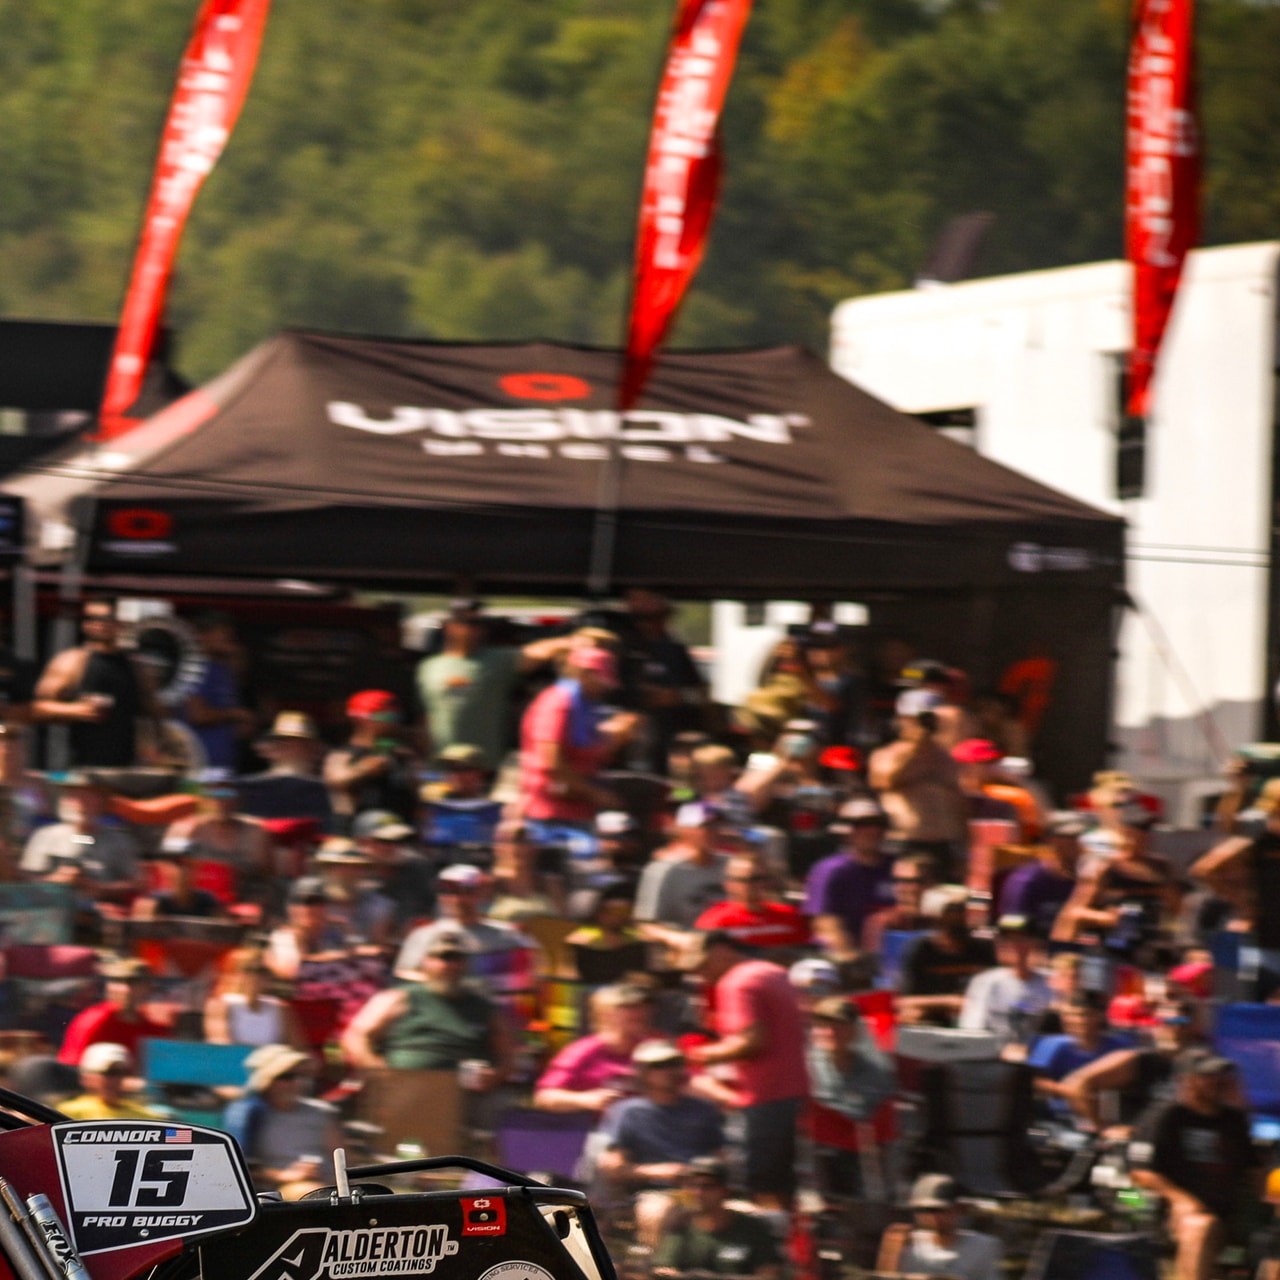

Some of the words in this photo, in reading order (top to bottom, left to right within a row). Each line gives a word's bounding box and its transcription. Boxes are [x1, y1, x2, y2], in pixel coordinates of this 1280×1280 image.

[327, 401, 791, 443] VISION
[64, 1130, 161, 1143] CONNOR
[108, 1150, 194, 1207] 15
[82, 1216, 127, 1227] PRO
[132, 1215, 204, 1227] BUGGY
[41, 1221, 81, 1275] FOX
[324, 1229, 444, 1262] ALDERTON
[333, 1262, 378, 1275] CUSTOM
[379, 1259, 432, 1272] COATINGS
[501, 1263, 540, 1274] SERVICES
